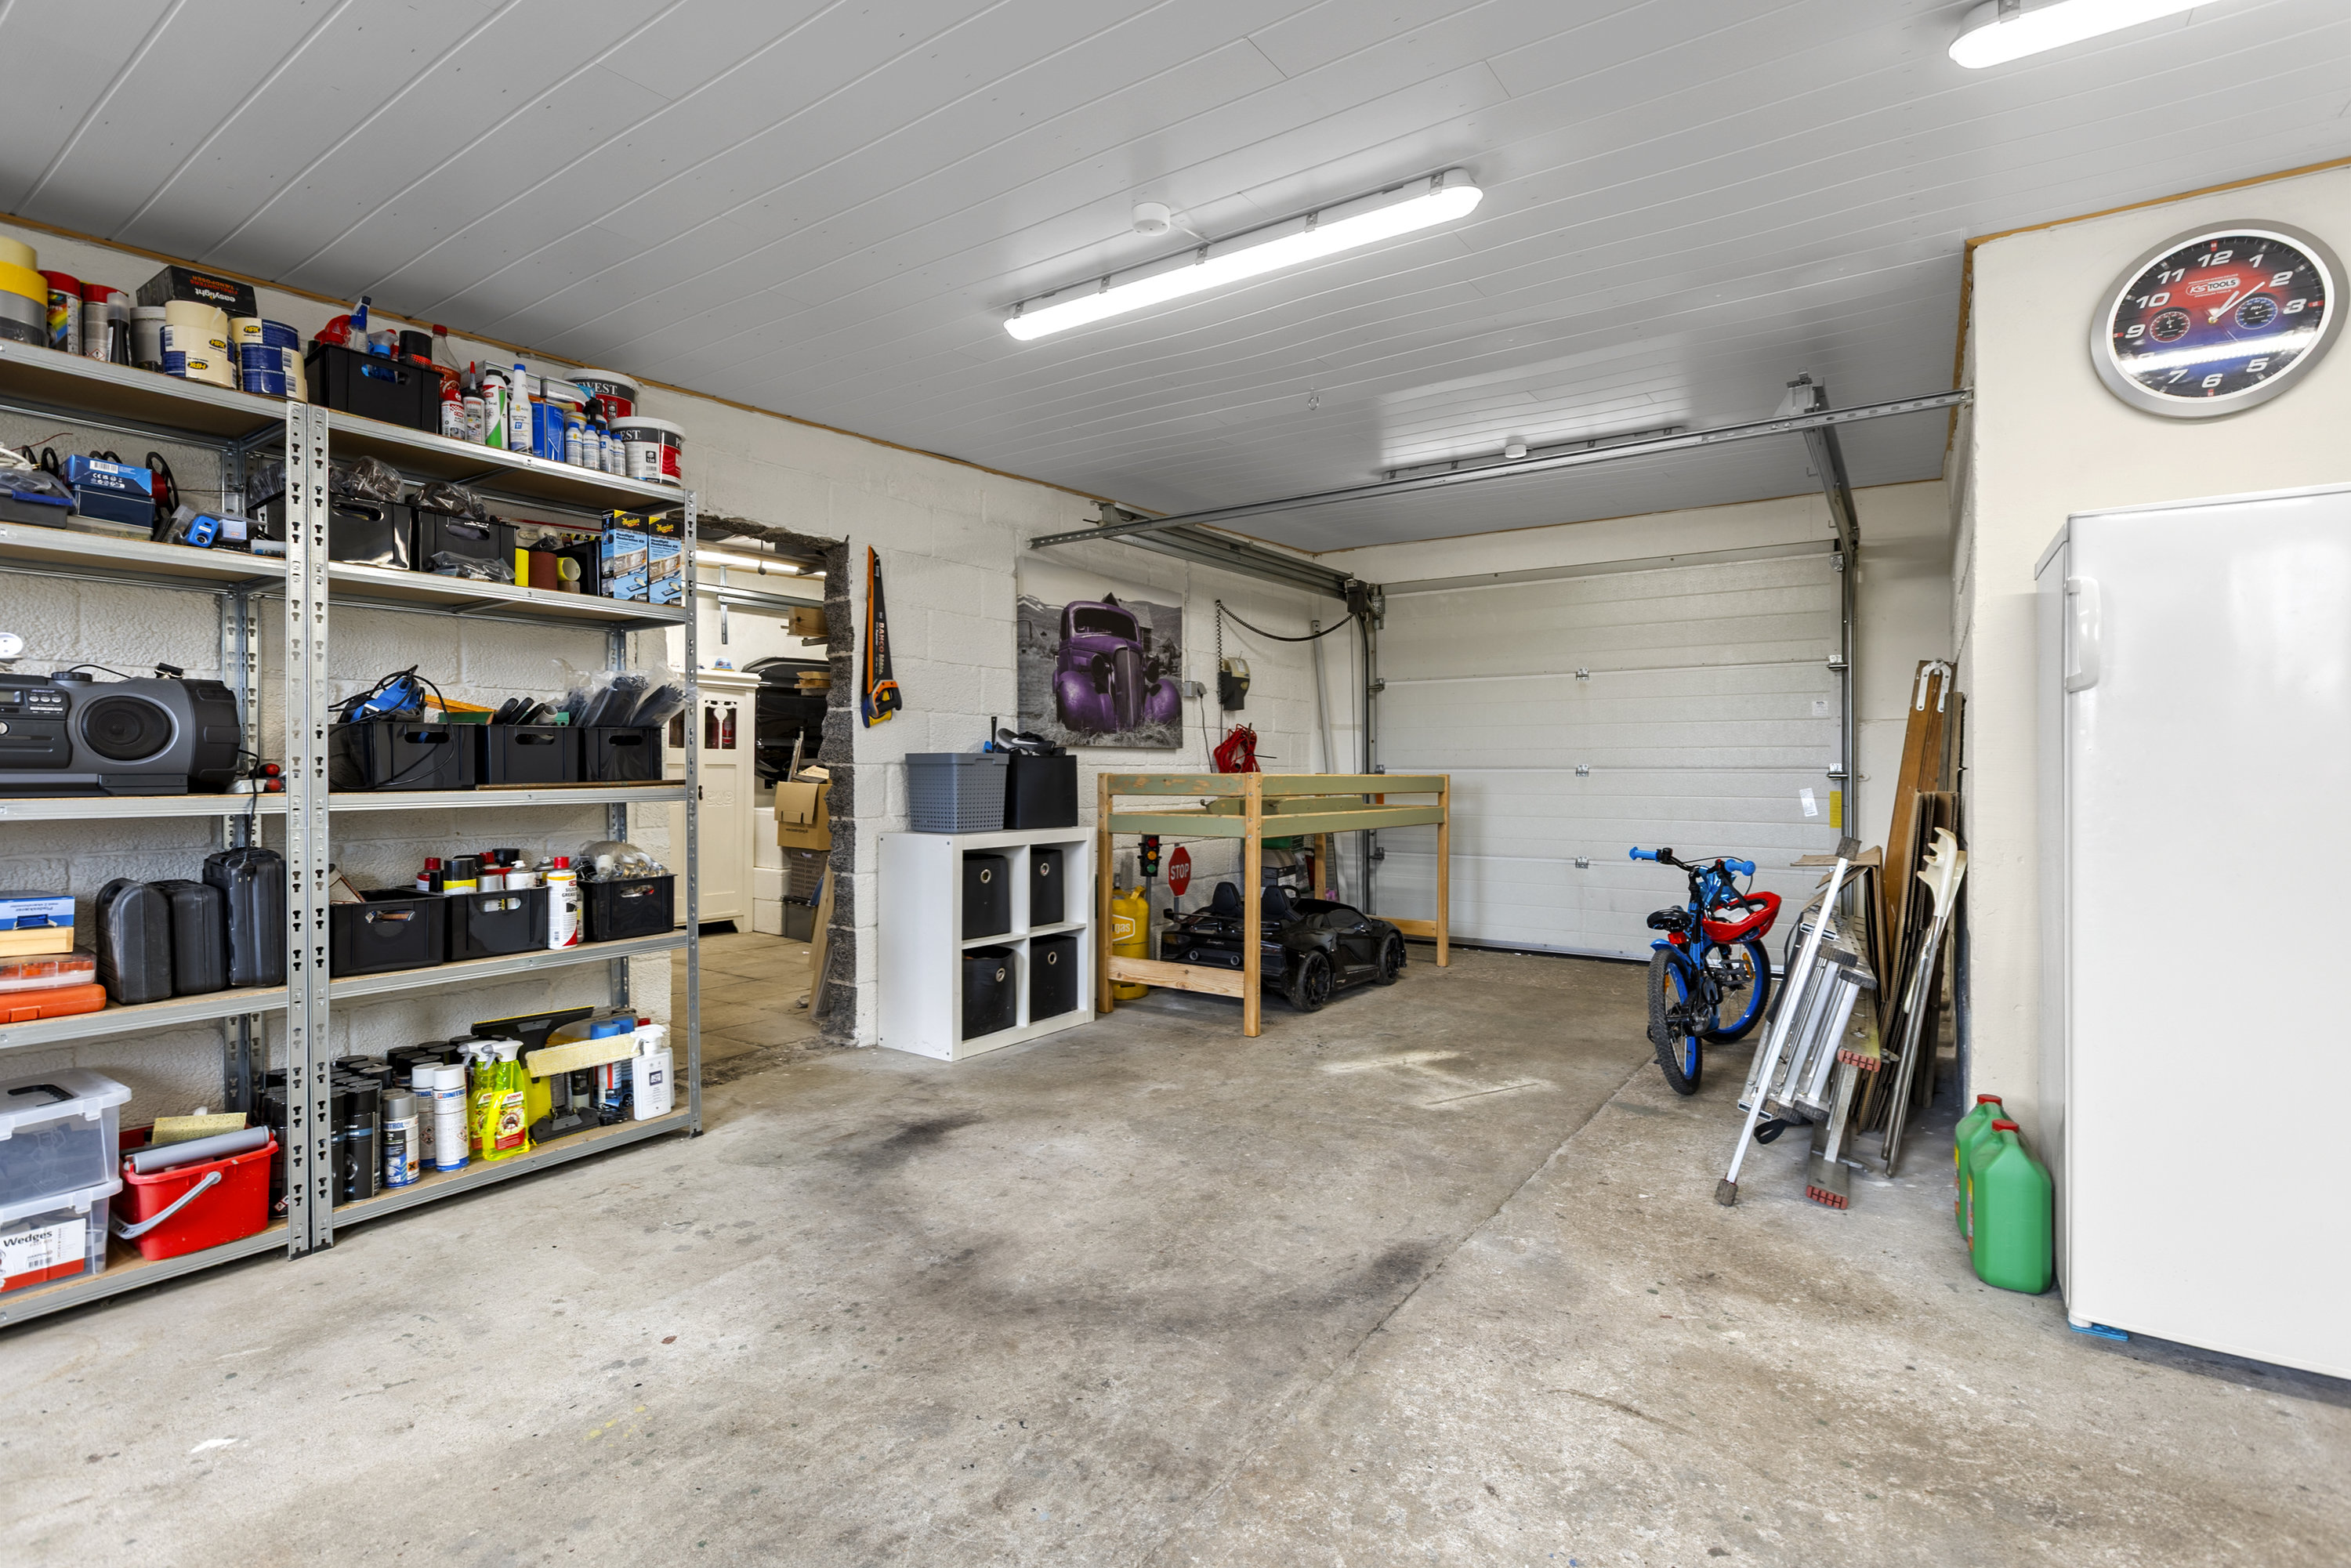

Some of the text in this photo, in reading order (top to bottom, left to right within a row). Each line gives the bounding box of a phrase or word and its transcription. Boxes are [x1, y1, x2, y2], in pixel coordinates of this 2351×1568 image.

[2197, 250, 2233, 267] 12
[2248, 254, 2263, 268] 1
[2157, 268, 2185, 284] 11
[2269, 271, 2293, 288] 2
[2208, 279, 2237, 289] TOOLS
[195, 288, 236, 302] easylight
[2136, 292, 2171, 309] 10
[2283, 299, 2307, 314] 3
[2125, 324, 2146, 339] 9
[211, 339, 226, 349] HPX
[189, 361, 207, 370] HPX
[2246, 357, 2269, 373] 5
[2168, 369, 2189, 384] 7
[2201, 373, 2223, 388] 6
[1170, 863, 1190, 881] STOP
[3, 1230, 53, 1247] Wedges
